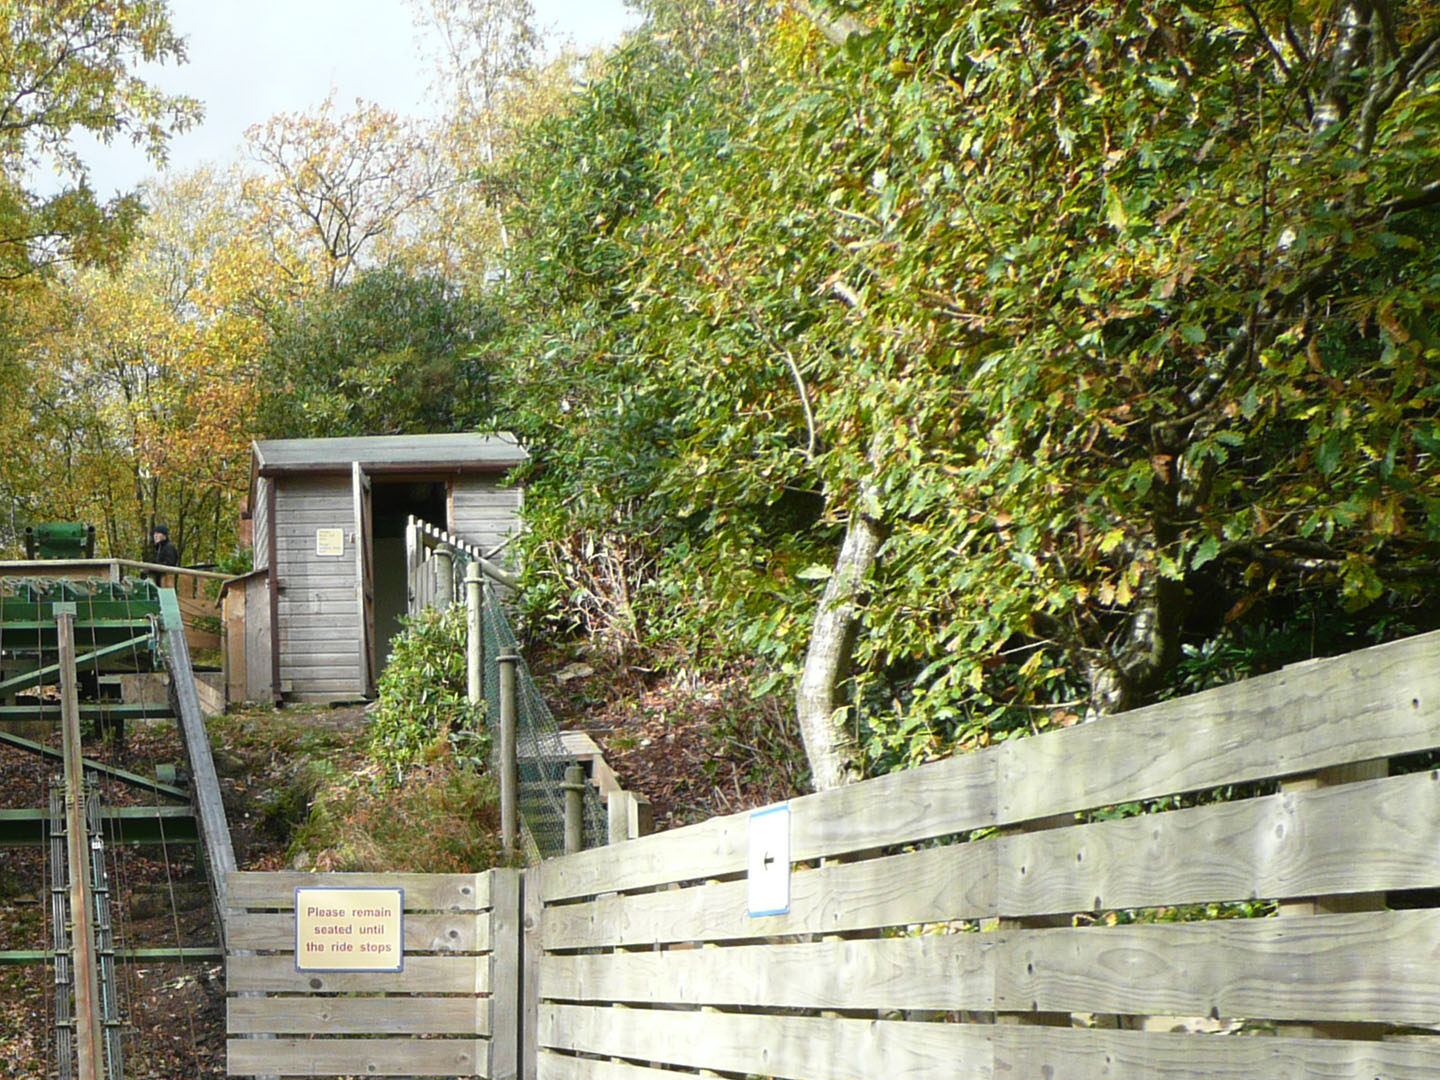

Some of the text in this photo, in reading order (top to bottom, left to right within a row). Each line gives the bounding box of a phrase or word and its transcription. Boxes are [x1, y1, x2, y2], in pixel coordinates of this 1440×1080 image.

[307, 906, 392, 917] Please remain
[314, 924, 384, 935] seated until
[306, 942, 392, 954] the ride stops
